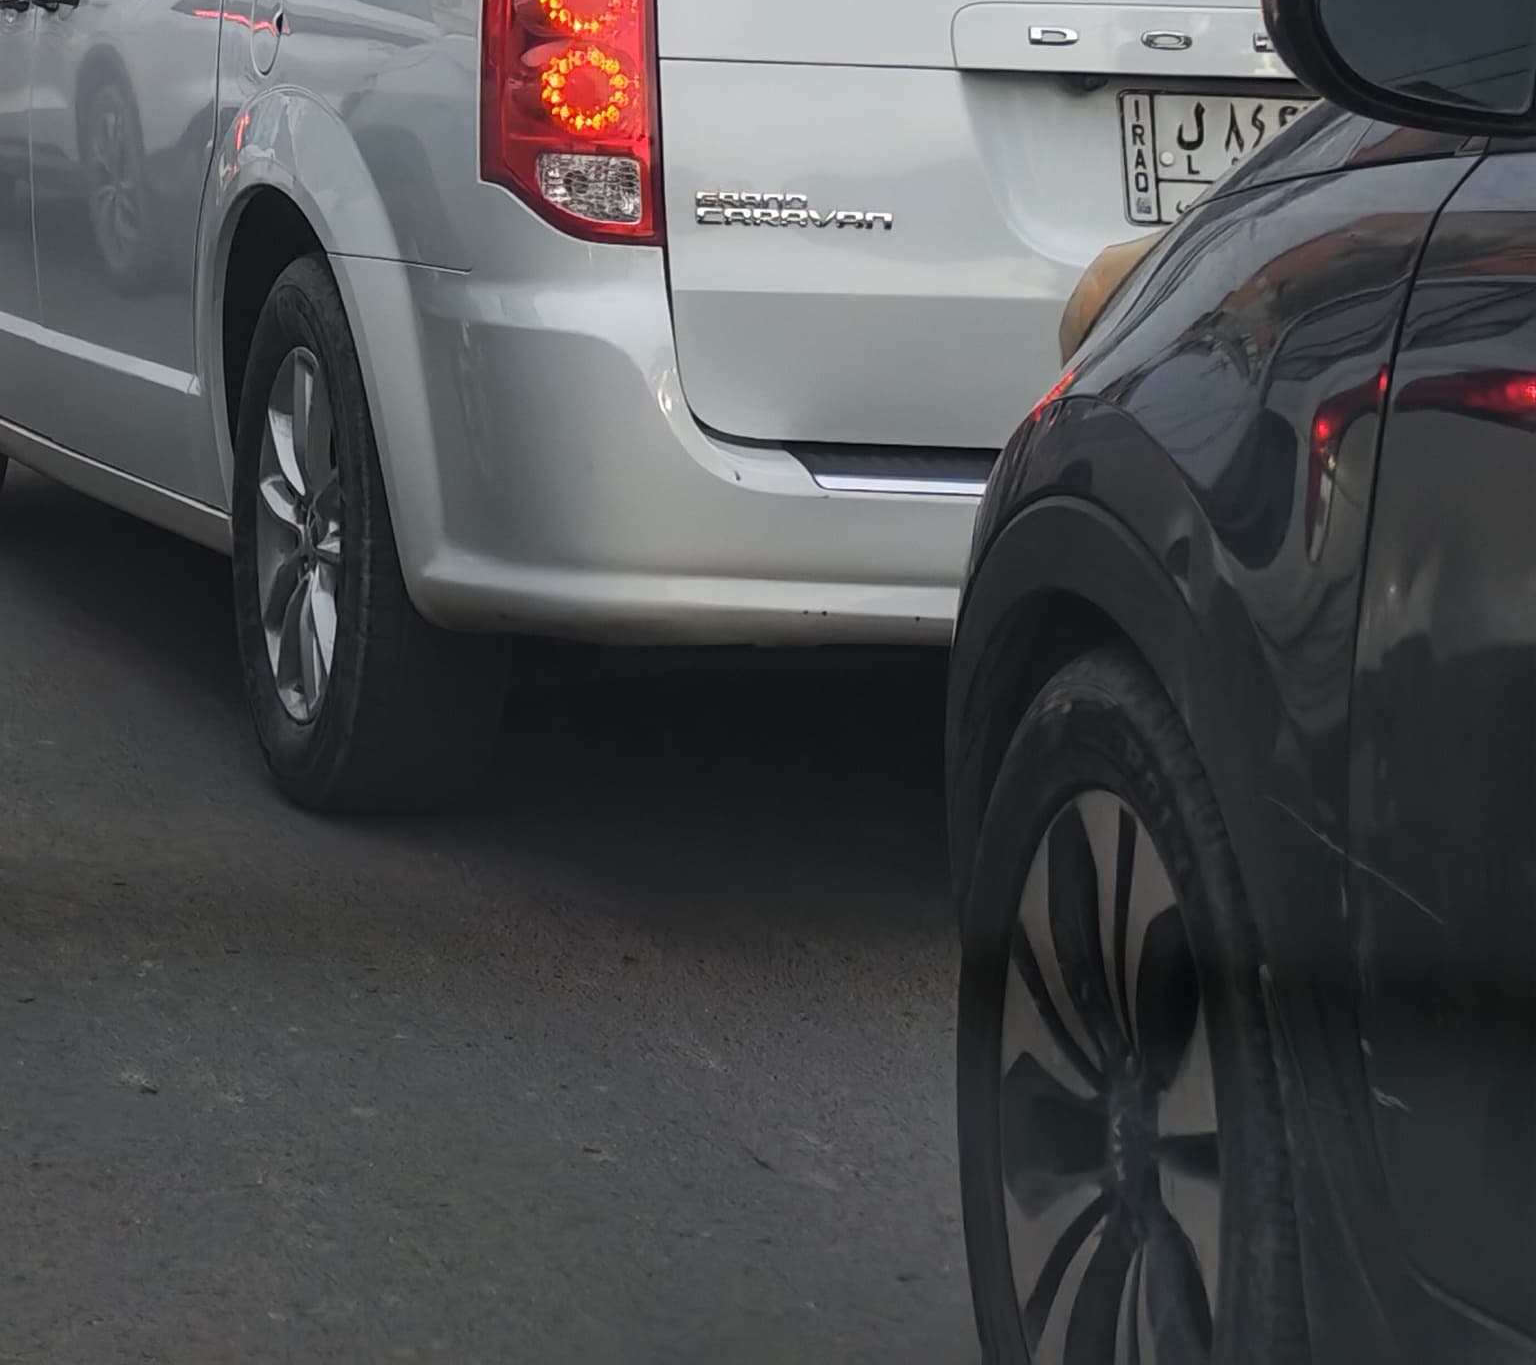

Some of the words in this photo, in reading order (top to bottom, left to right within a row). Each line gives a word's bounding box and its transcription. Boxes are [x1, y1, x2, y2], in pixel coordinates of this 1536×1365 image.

[1130, 99, 1150, 194] IRAQ
[1186, 154, 1201, 176] L
[695, 191, 808, 209] GRAND
[696, 207, 893, 231] CARAVAN
